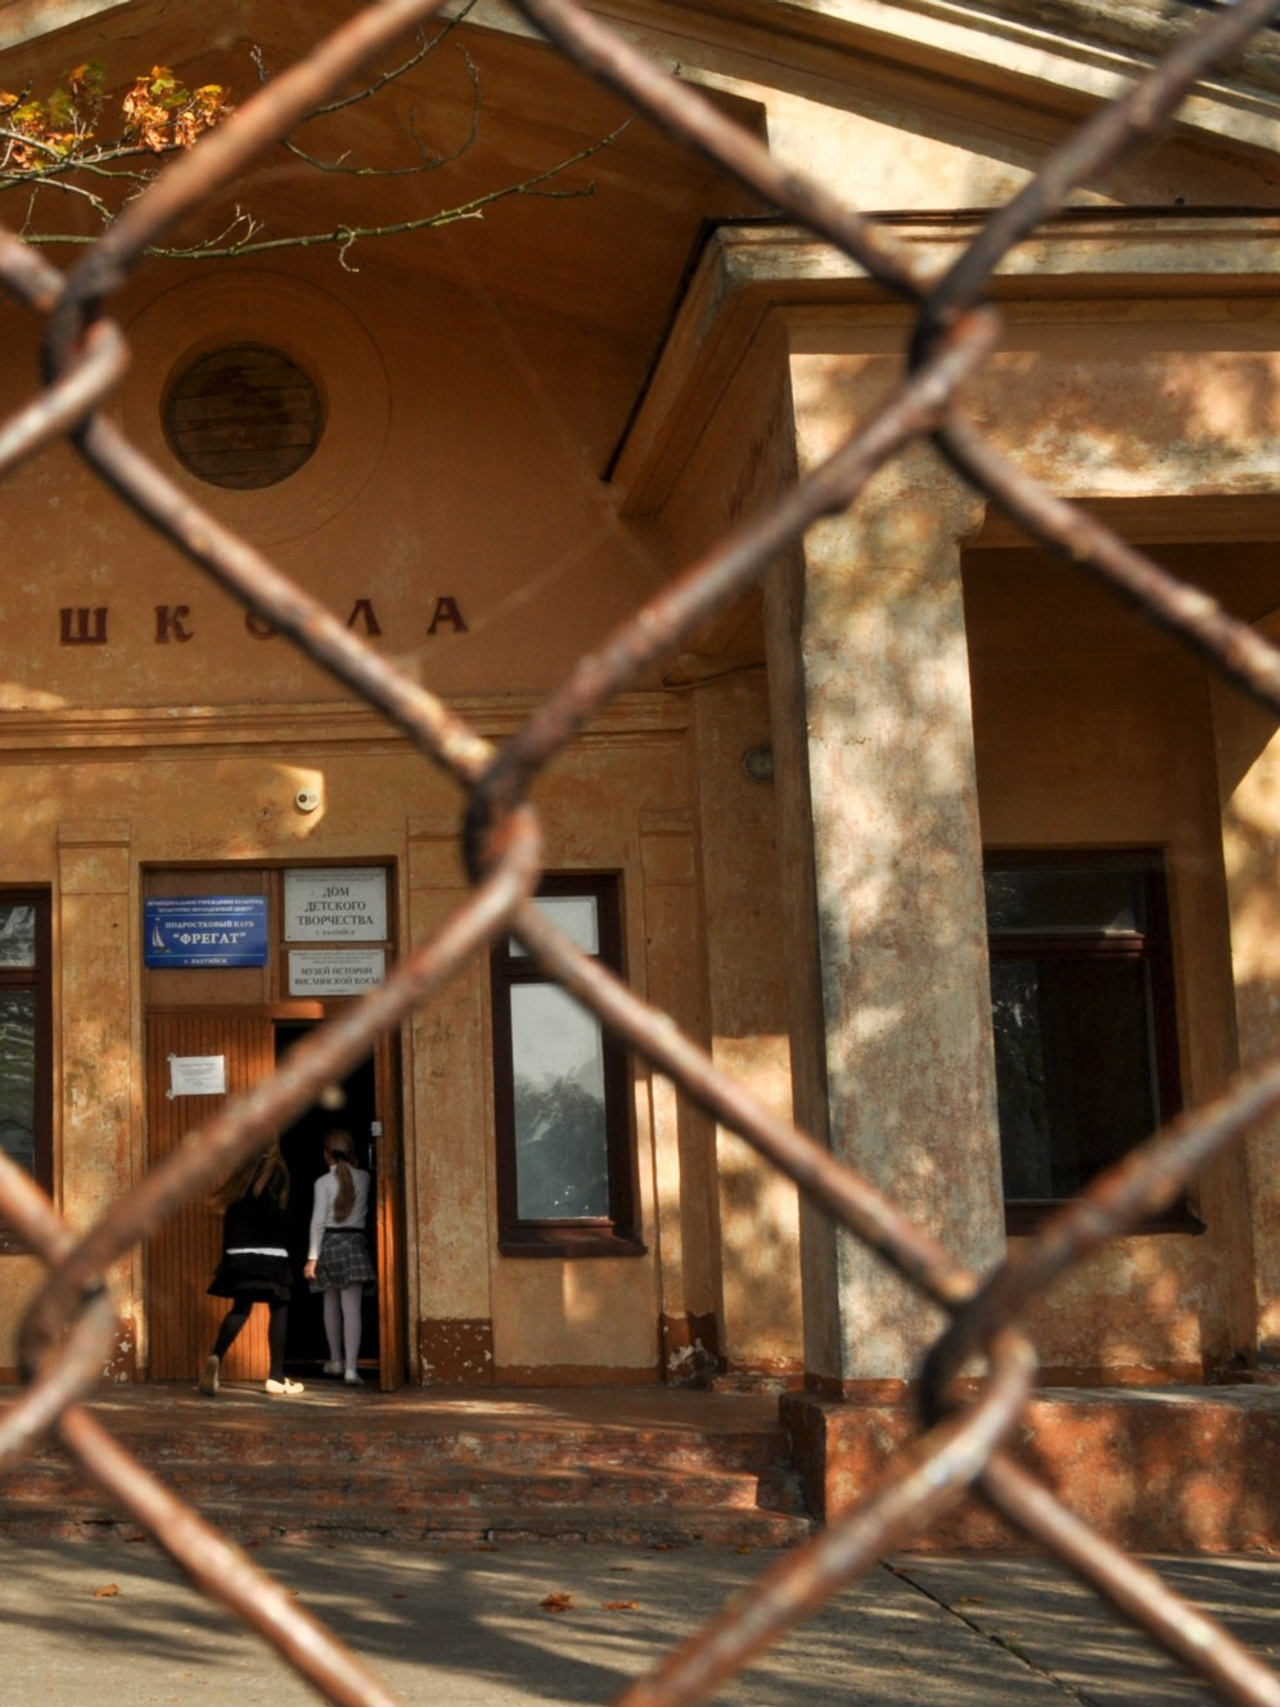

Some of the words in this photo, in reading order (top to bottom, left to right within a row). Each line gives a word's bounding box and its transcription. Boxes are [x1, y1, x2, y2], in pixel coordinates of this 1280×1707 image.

[322, 886, 350, 898] ДОМ
[304, 901, 367, 912] ДЕТСКОГО
[165, 920, 232, 928] ПОДРОСТКОВЫЙ
[296, 915, 374, 925] ТВОРЧЕСТВА
[301, 965, 331, 975] МУЗЕЙ
[332, 967, 373, 975] ИСТОРИИ
